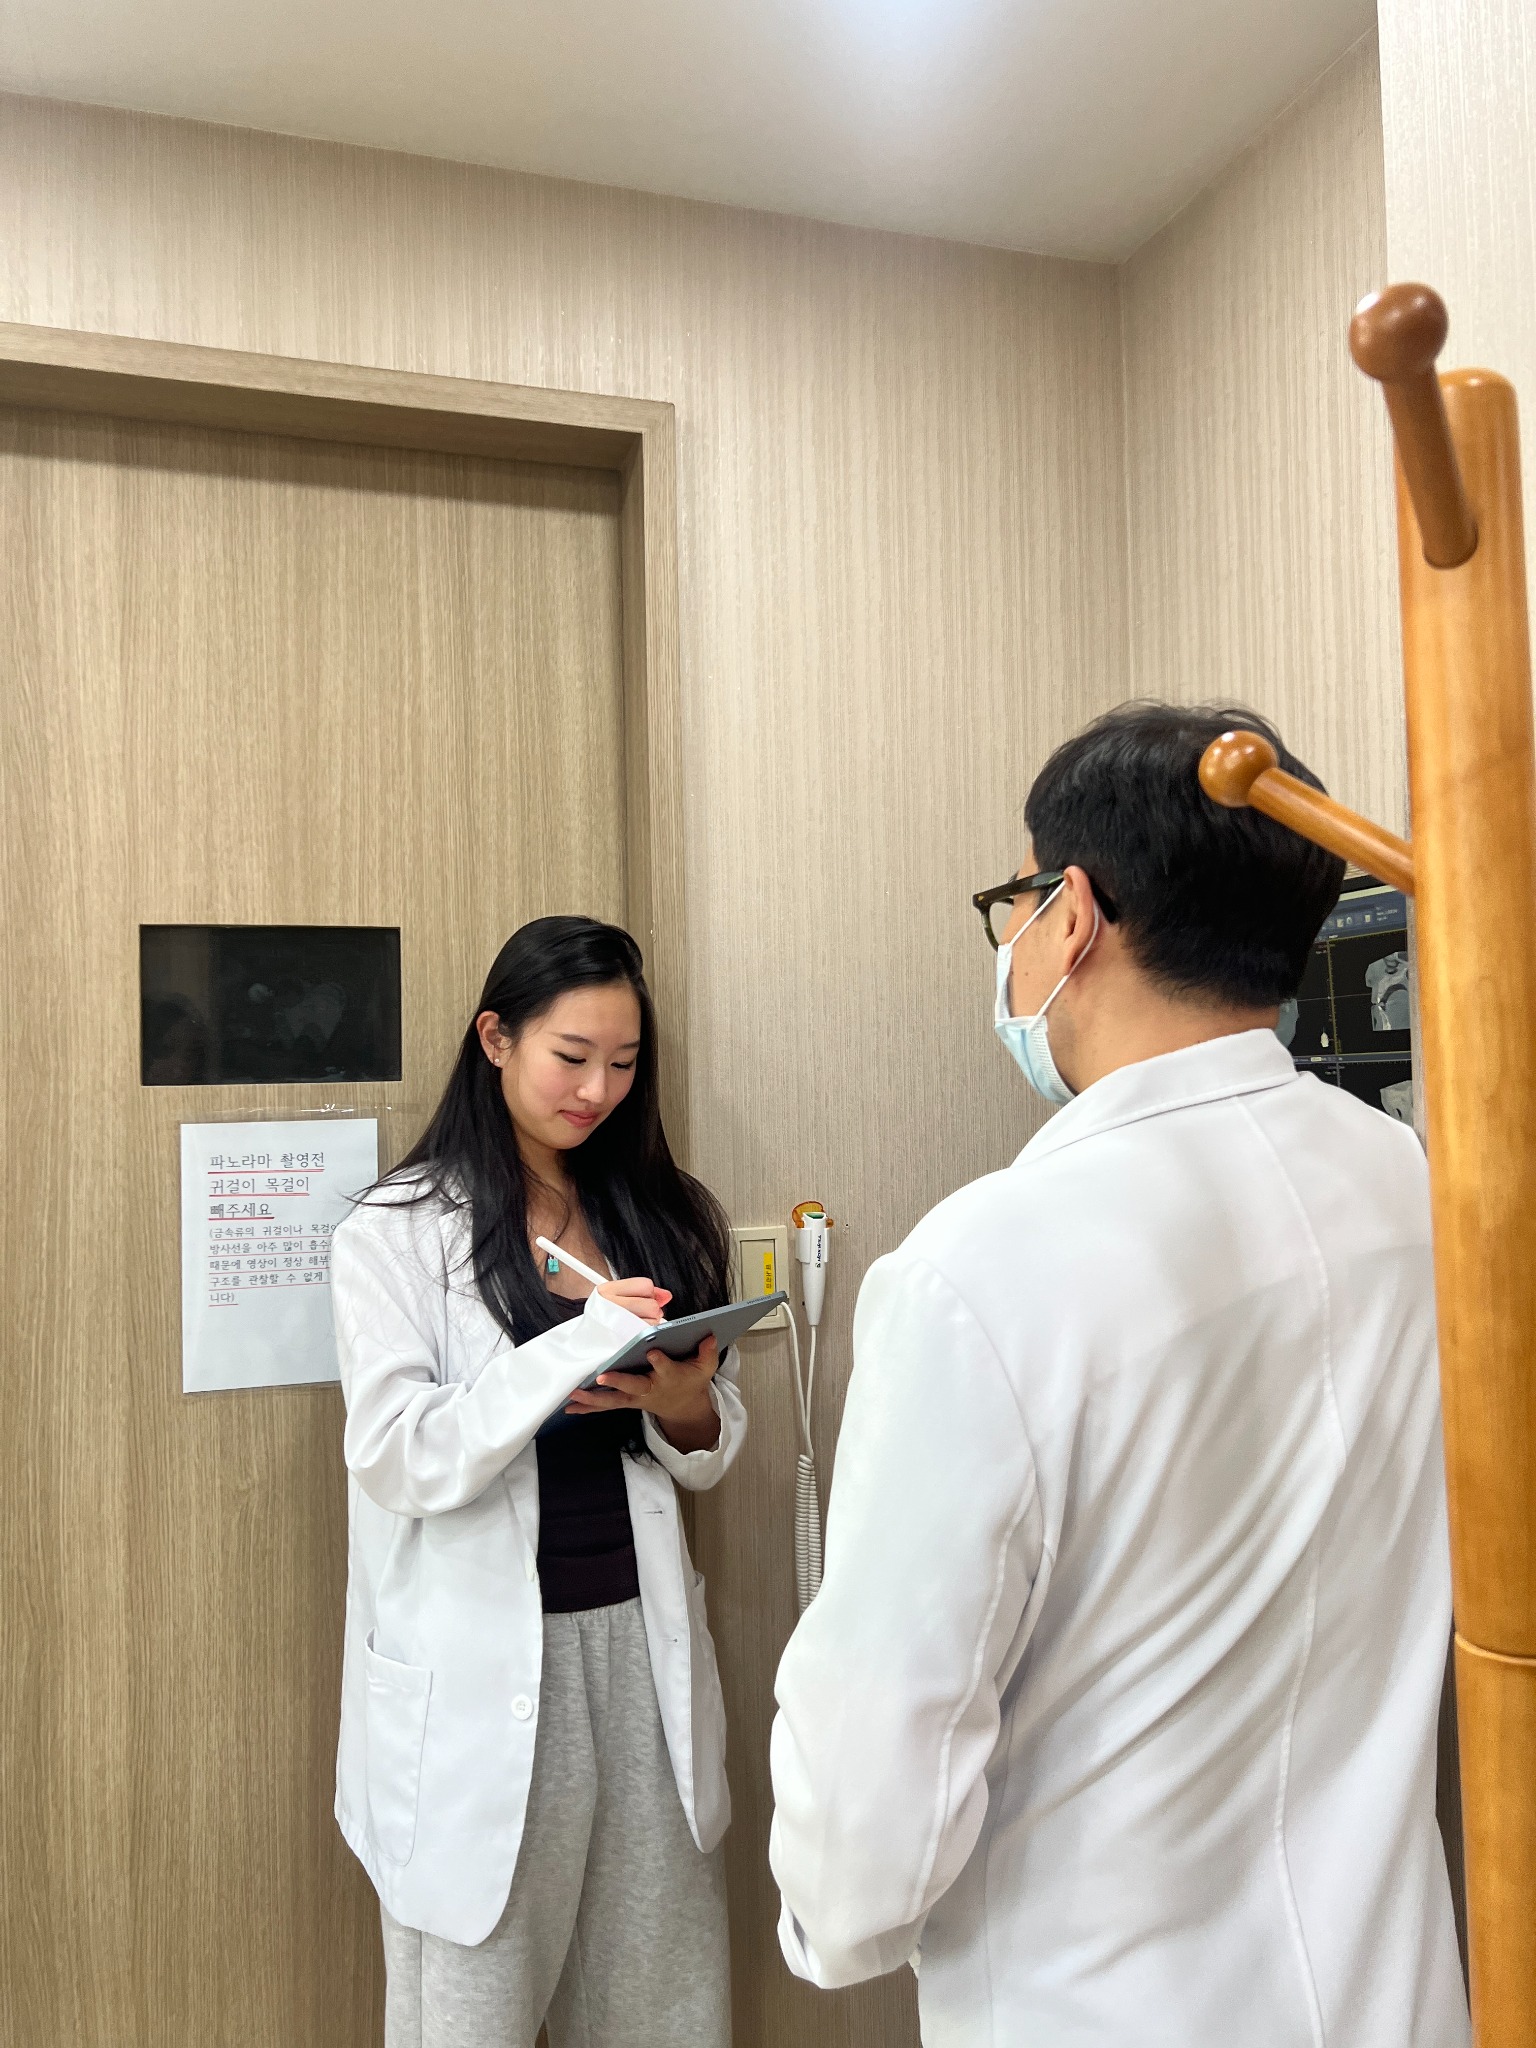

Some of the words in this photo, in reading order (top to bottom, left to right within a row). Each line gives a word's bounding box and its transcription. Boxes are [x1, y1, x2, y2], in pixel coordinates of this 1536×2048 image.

[210, 1154, 272, 1169] 파노라마
[280, 1152, 324, 1168] 촬영전
[210, 1179, 255, 1194] 귀걸이
[266, 1177, 308, 1192] 목걸이
[210, 1203, 272, 1218] 빼주세요
[210, 1227, 254, 1238] (금속류의
[263, 1225, 303, 1236] 귀걸이나
[210, 1243, 251, 1255] 방사선을
[257, 1242, 277, 1252] 아주
[283, 1241, 302, 1251] 많이
[309, 1240, 331, 1250] 흡수
[210, 1260, 241, 1270] 때문에
[247, 1258, 277, 1268] 영상이
[283, 1257, 303, 1267] 정상
[309, 1256, 331, 1265] 해부
[210, 1276, 241, 1287] 구조를
[249, 1274, 279, 1285] 관찰할
[286, 1274, 296, 1283] 수
[304, 1272, 323, 1282] 없게
[210, 1293, 234, 1303] 니다)
